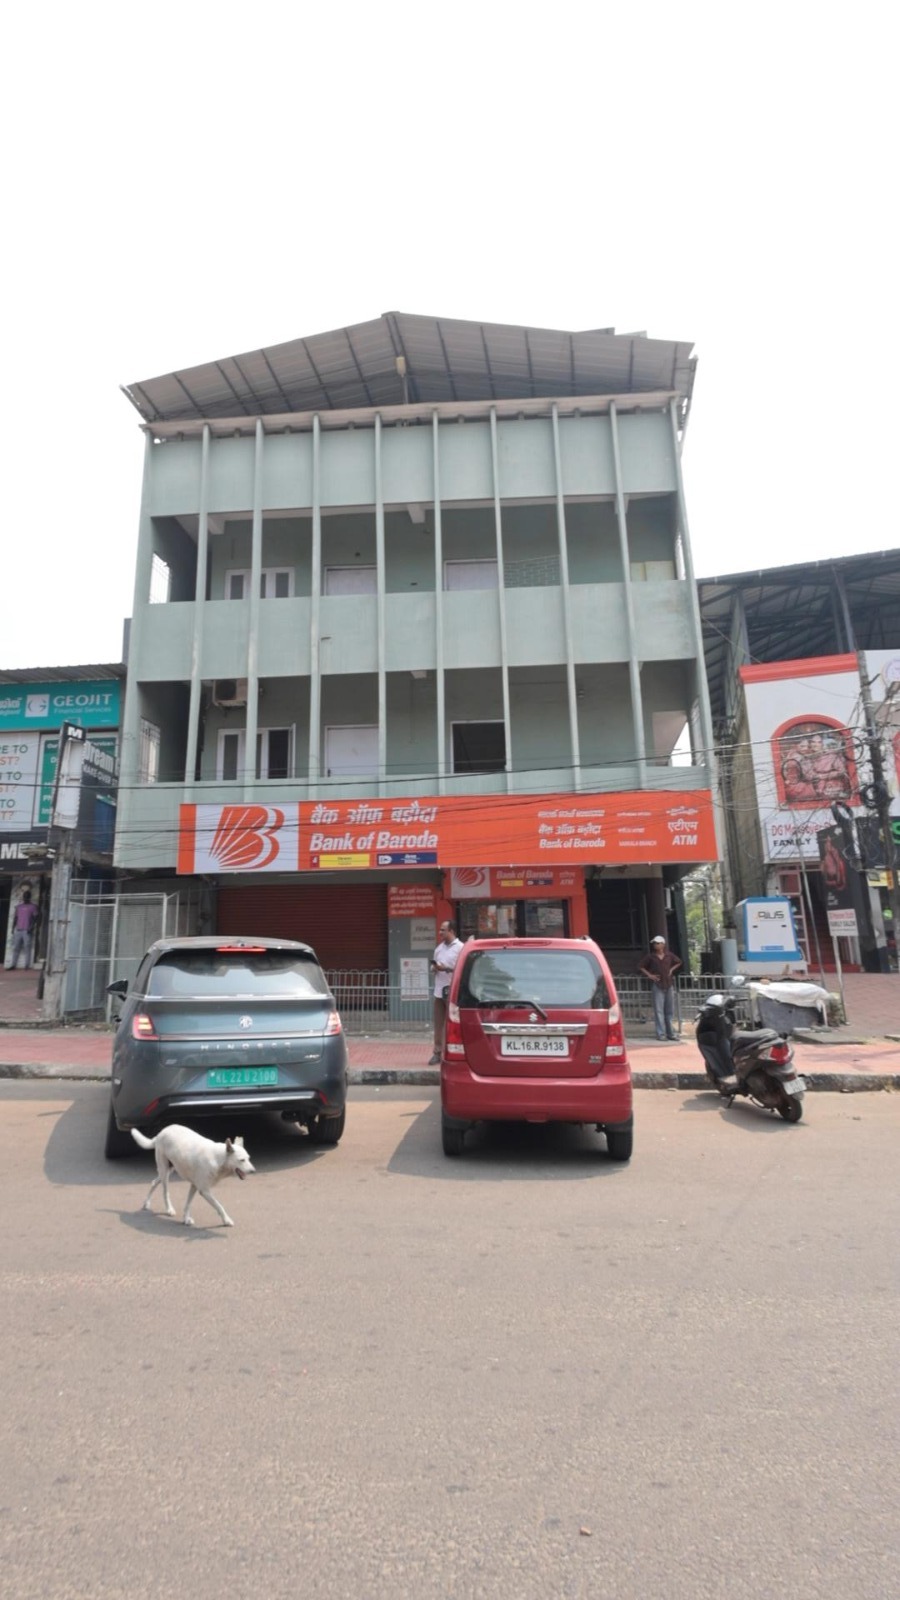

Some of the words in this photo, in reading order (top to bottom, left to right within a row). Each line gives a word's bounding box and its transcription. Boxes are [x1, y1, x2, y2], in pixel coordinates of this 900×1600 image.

[53, 694, 112, 707] GEOJIT
[67, 726, 83, 739] M
[12, 744, 28, 754] TO
[7, 771, 21, 781] TO
[0, 799, 15, 808] TO
[310, 804, 339, 824] बैंक
[309, 832, 353, 851] Bank
[356, 831, 375, 850] of
[376, 830, 438, 849] Baroda
[540, 838, 562, 848] Bank
[563, 838, 573, 848] of
[573, 838, 606, 848] Baroda
[672, 834, 698, 845] ATM
[496, 870, 516, 879] Bank
[526, 869, 553, 879] Baroda
[506, 1041, 565, 1051] KL.16.R.9138
